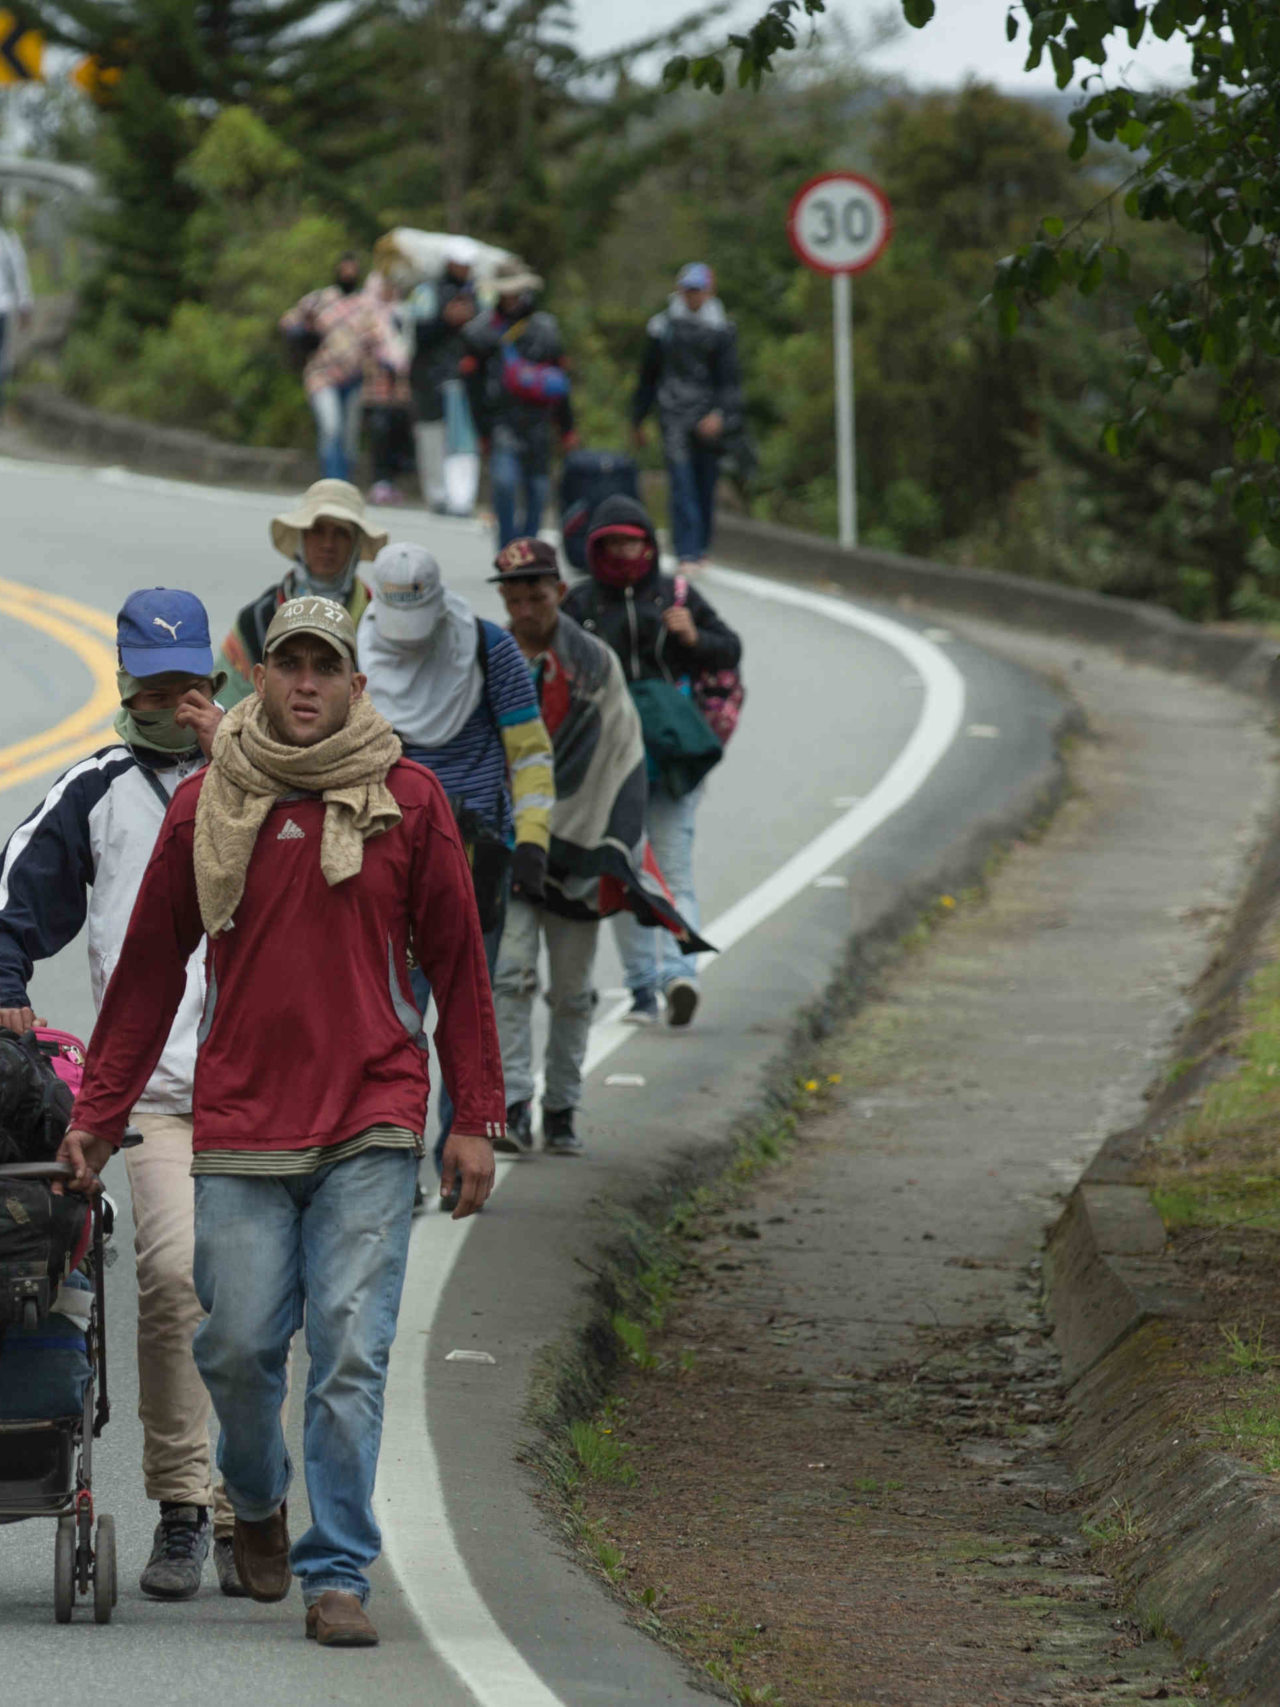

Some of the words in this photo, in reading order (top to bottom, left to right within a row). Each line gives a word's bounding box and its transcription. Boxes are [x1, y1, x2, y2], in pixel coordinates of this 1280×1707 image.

[810, 198, 873, 246] 30
[283, 603, 304, 618] 40
[324, 606, 344, 623] 27
